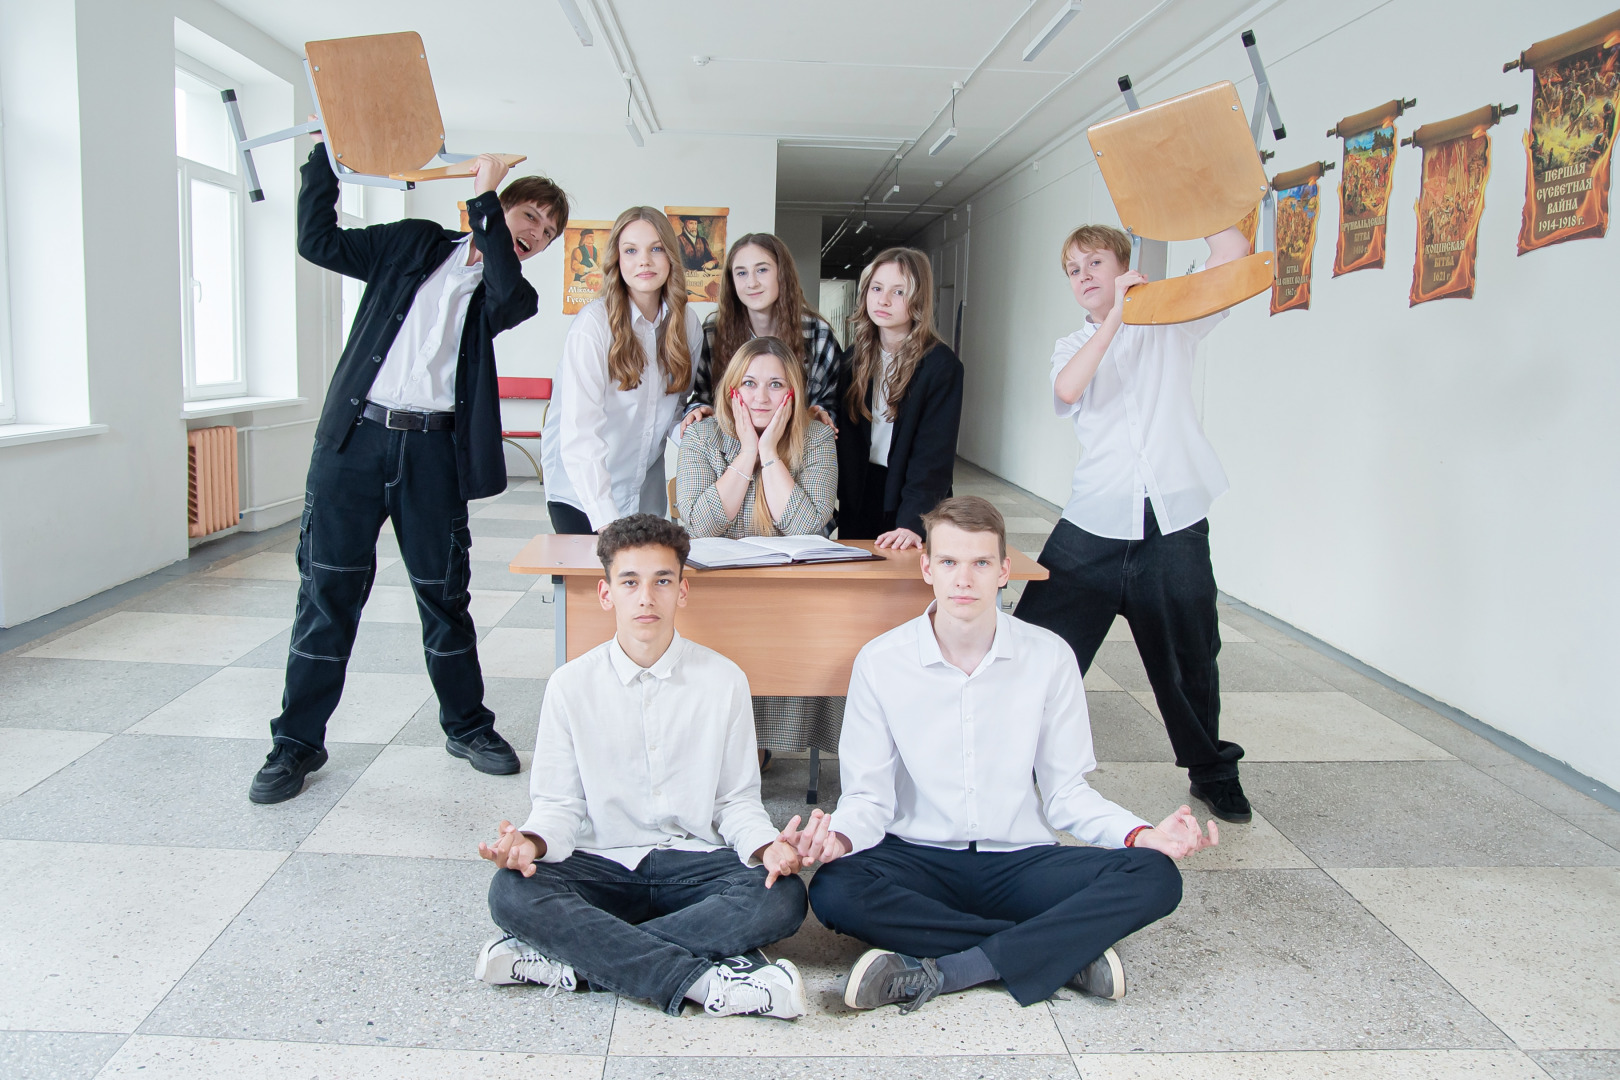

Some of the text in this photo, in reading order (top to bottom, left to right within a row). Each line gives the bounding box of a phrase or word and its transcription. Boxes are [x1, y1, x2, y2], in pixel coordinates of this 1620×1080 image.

[1544, 161, 1587, 183] ПЕРШАЯ
[1536, 177, 1593, 203] СУСВЕТНАЯ
[1546, 197, 1578, 215] ВАЙНА
[1538, 215, 1577, 233] 1914-1918
[1433, 255, 1455, 268] БІТВА
